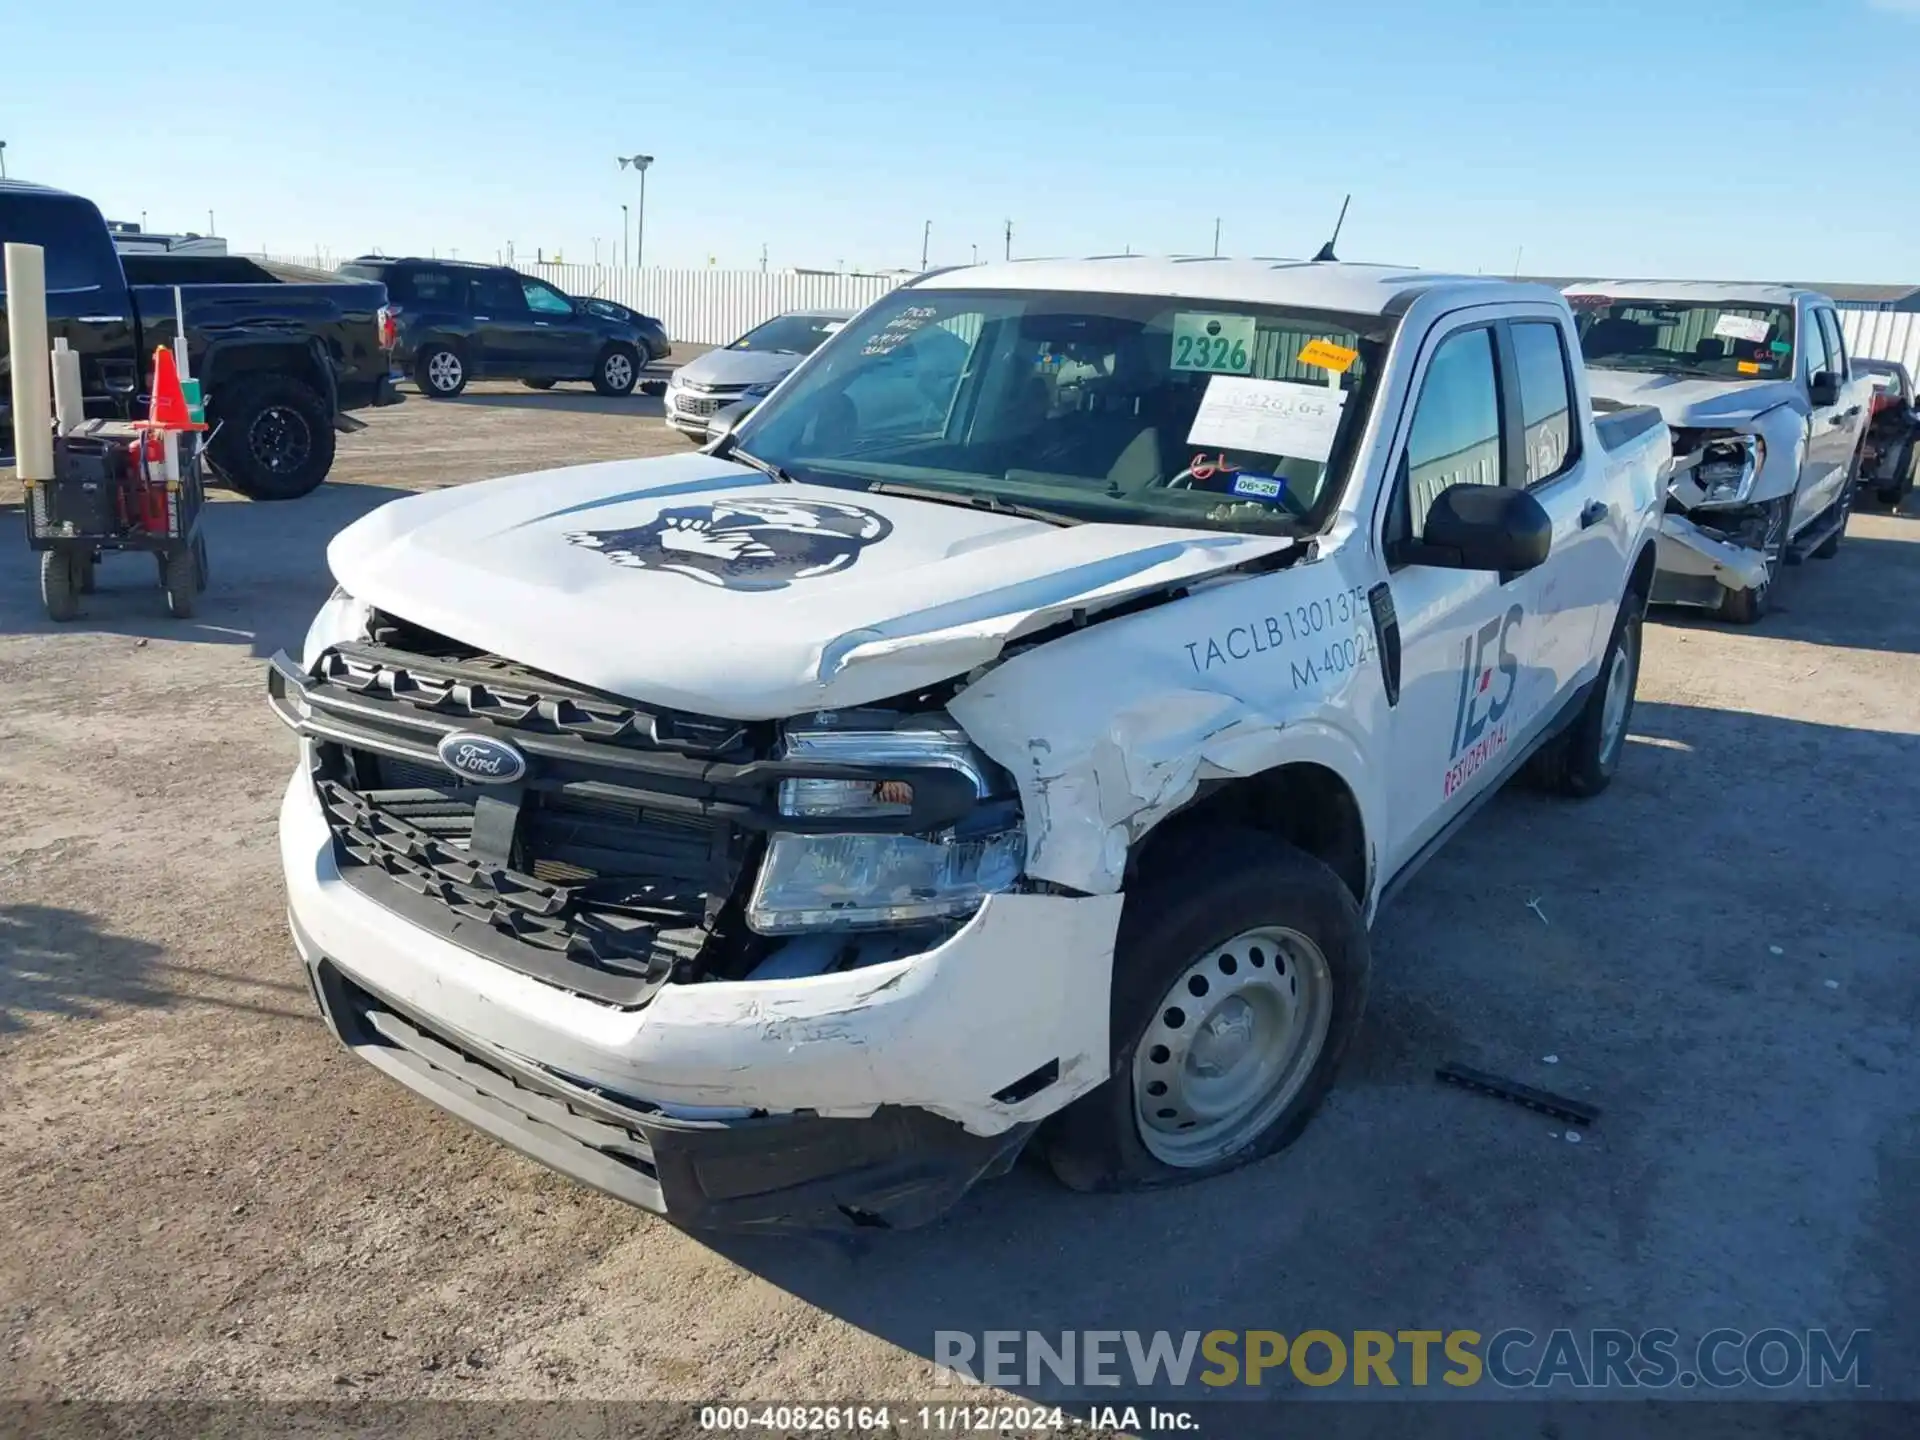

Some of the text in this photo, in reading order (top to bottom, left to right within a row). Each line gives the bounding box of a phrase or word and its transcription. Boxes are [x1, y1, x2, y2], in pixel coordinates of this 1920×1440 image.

[1175, 335, 1247, 370] 2326
[1449, 603, 1525, 763] IES
[456, 743, 502, 774] Ford
[1443, 725, 1508, 800] RESIDENTIAL
